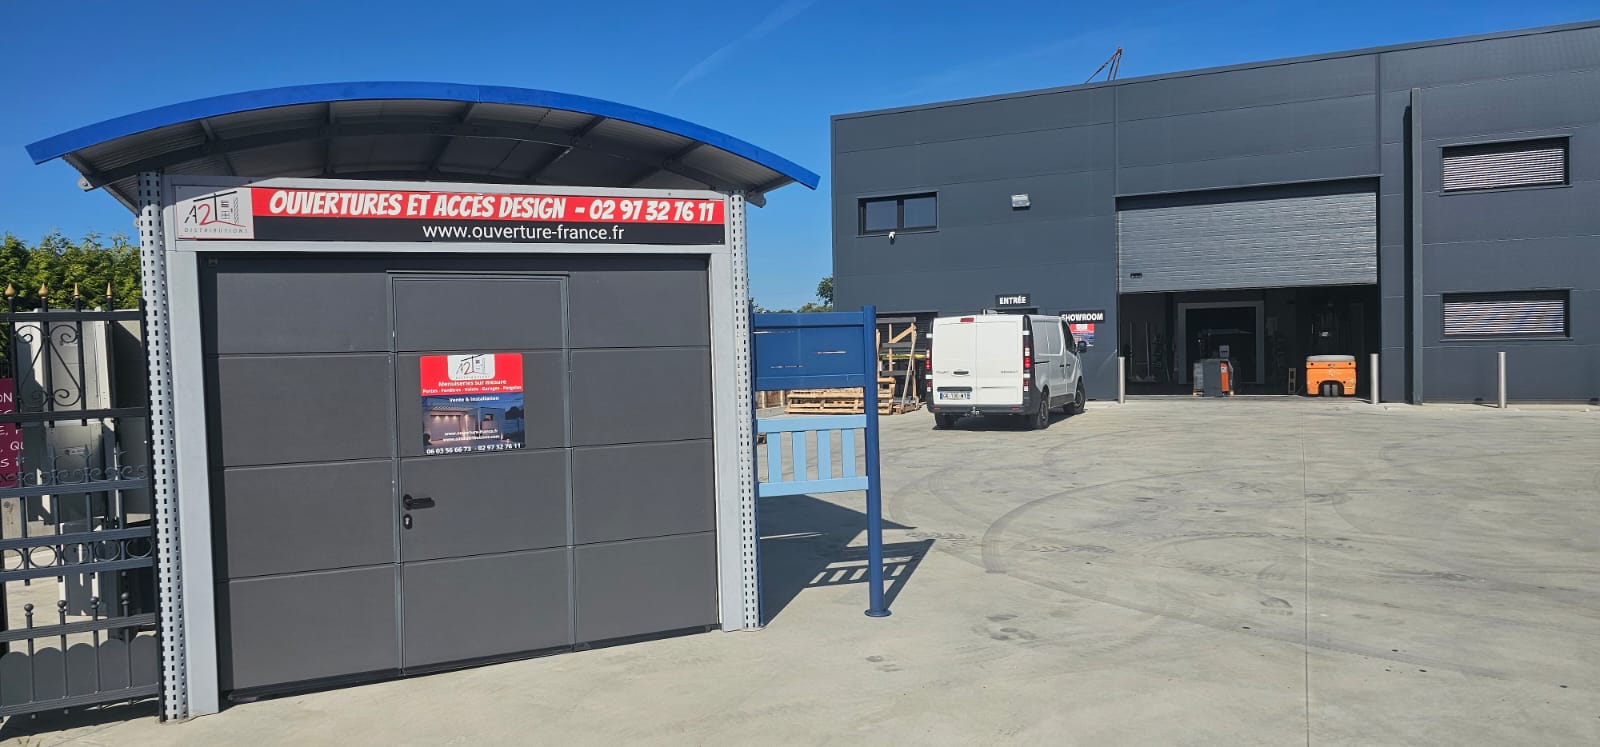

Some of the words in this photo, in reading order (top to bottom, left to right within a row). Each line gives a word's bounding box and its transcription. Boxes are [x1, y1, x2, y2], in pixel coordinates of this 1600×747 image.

[269, 190, 401, 216] OUVERTURES
[406, 193, 432, 216] ET
[499, 195, 566, 219] DESIGN
[589, 198, 614, 220] 02
[620, 199, 641, 221] 97
[645, 200, 671, 221] 32
[674, 201, 695, 222] 76
[697, 202, 715, 222] 11
[422, 225, 625, 240] www.ouverture-france.fr
[999, 296, 1027, 305] ENTRÉE
[1061, 312, 1104, 321] SHOWROOM
